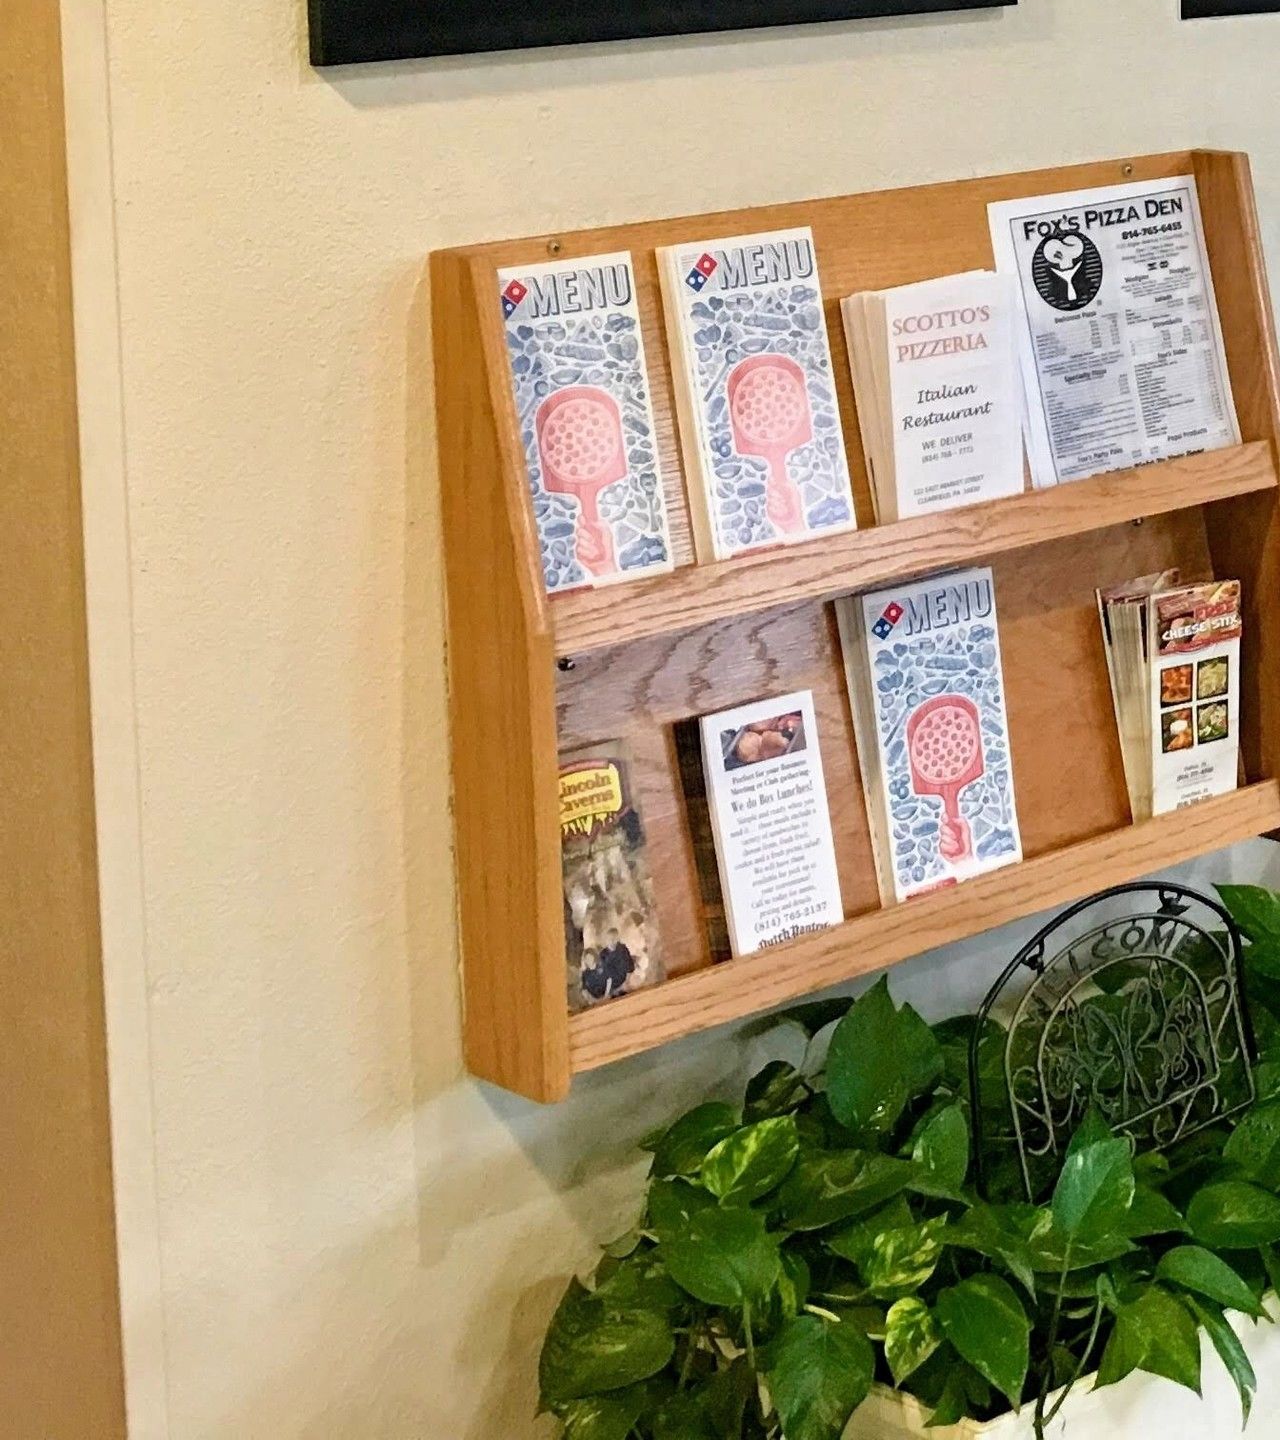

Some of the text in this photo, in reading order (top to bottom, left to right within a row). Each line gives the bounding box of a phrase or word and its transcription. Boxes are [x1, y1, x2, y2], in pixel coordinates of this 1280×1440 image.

[714, 240, 813, 291] MENU
[526, 263, 632, 319] MENU
[893, 305, 990, 337] SCOTTO'S
[897, 332, 988, 363] PIZZERIA
[917, 382, 978, 404] Italian
[902, 401, 993, 431] Restaurant
[922, 432, 973, 450] WE DELIVER
[903, 578, 992, 636] MENU
[1162, 622, 1208, 640] CHEESE
[731, 800, 744, 813] We
[759, 792, 774, 806] Box
